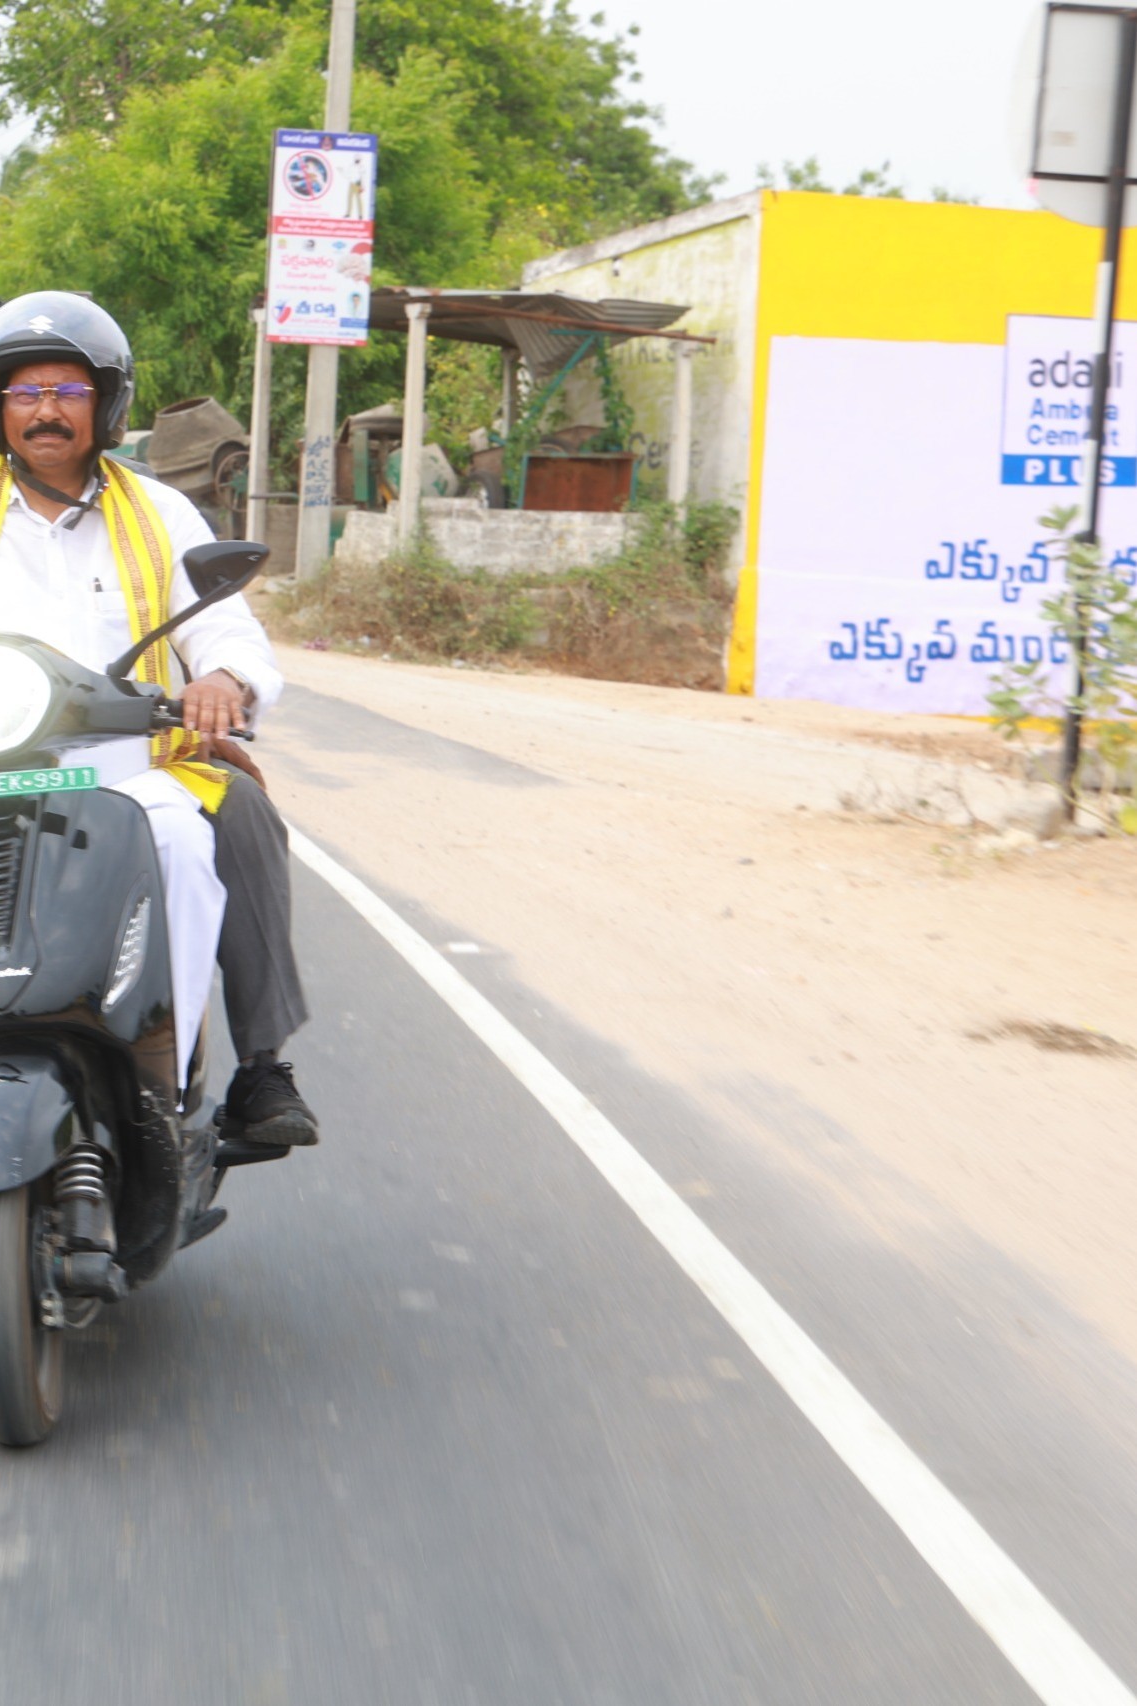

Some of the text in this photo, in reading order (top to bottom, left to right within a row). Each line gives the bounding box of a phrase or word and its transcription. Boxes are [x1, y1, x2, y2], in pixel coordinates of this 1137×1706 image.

[1028, 350, 1123, 388] adai
[1030, 398, 1118, 420] Amba
[1027, 425, 1119, 446] Cemt
